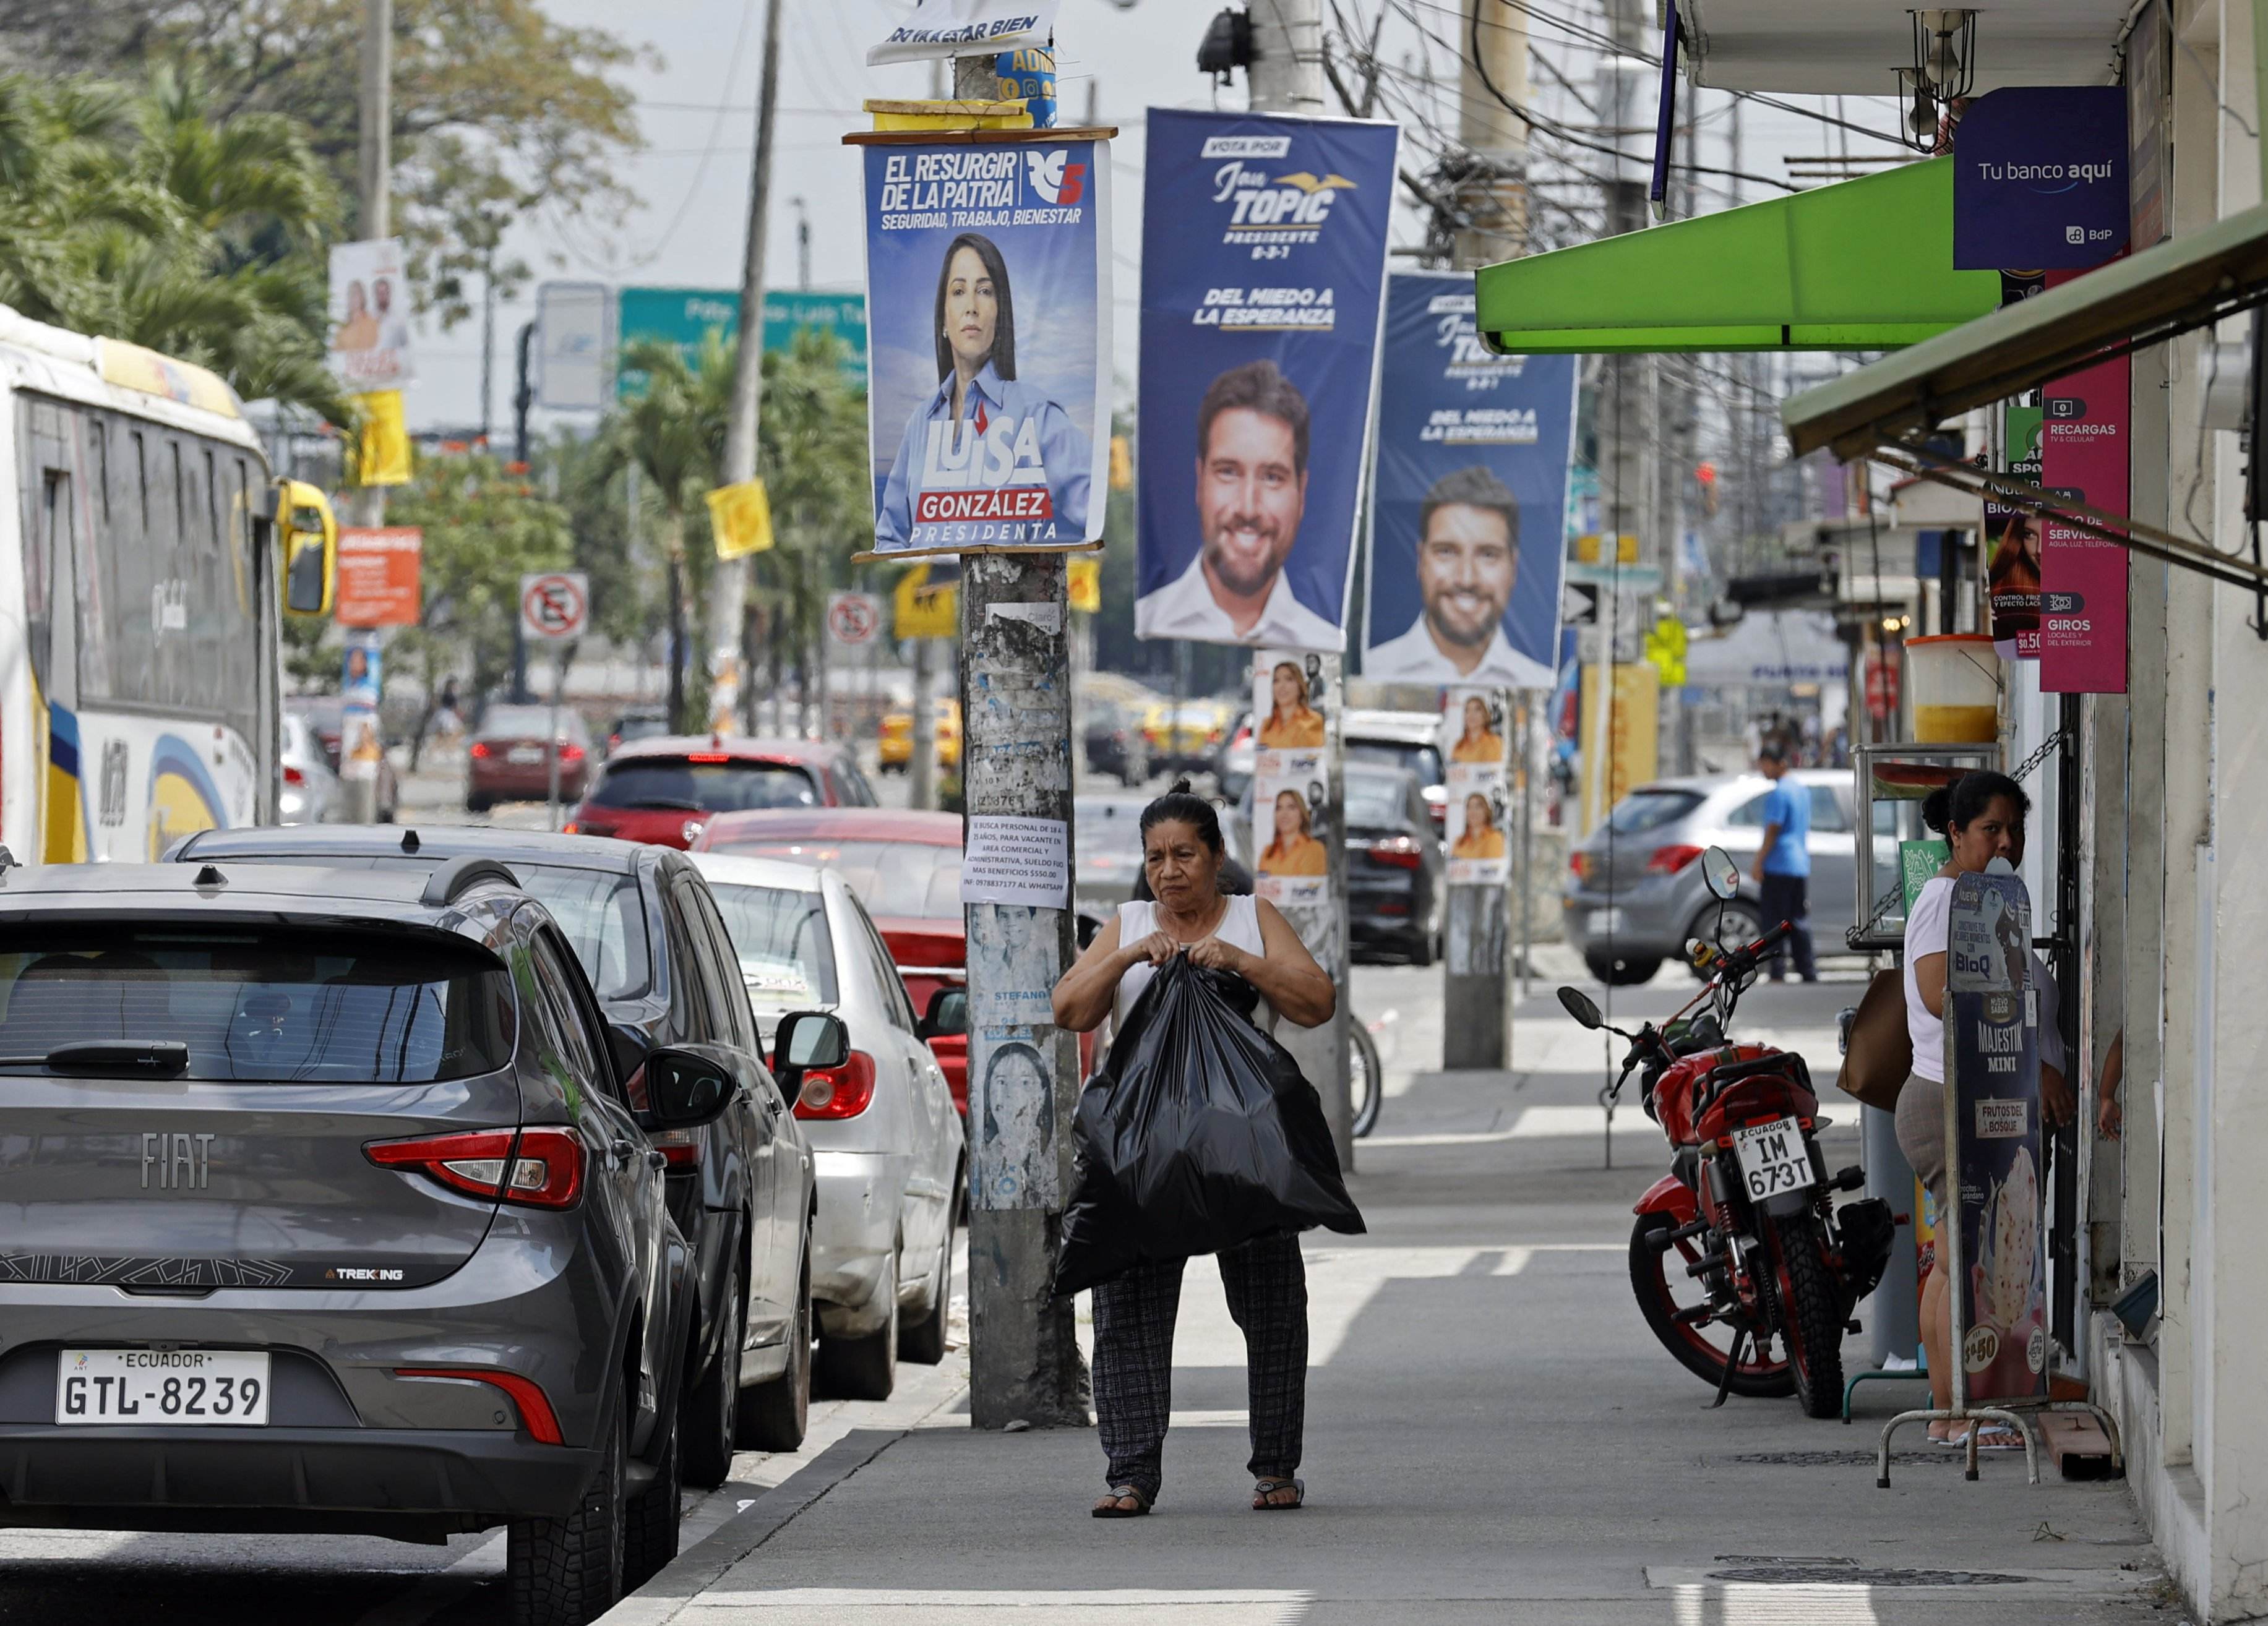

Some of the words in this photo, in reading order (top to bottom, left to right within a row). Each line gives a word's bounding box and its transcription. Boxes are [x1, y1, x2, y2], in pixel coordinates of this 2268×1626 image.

[989, 15, 1038, 35] BIEN
[1211, 142, 1246, 152] VOTA
[1251, 141, 1281, 152] POR
[885, 155, 910, 182] EL
[915, 152, 1017, 182] RESURGIR
[1978, 163, 2002, 180] Tu
[2007, 161, 2063, 179] banco
[2068, 160, 2113, 183] aquí
[881, 182, 909, 210] DE
[912, 182, 940, 209] LA
[941, 180, 1015, 208] PATRIA
[1230, 189, 1335, 224] TOPIC
[882, 211, 948, 230] SEGURIDAD,
[951, 210, 1011, 228] TRABAJO,
[1013, 208, 1081, 225] BIENESTAR
[2089, 229, 2113, 240] BdP
[1204, 288, 1244, 306] DEL
[1247, 288, 1316, 306] MIEDO
[1315, 288, 1334, 306] A
[1192, 309, 1220, 325] LA
[1220, 308, 1335, 325] ESPERANZA
[2050, 424, 2116, 435] RECARGAS
[922, 489, 1045, 519] GONZÁLEZ
[909, 523, 1057, 543] PRESIDENTA
[2048, 620, 2090, 630] GIROS
[1000, 823, 1037, 832] PERSONAL
[1021, 836, 1052, 844] VACANTE
[1001, 845, 1042, 854] COMERCIAL
[1024, 858, 1052, 866] SUELDO
[987, 868, 1028, 876] BENEFICIOS
[1030, 869, 1057, 878] $550.00
[1028, 883, 1063, 891] WHATSAPP
[1991, 1006, 2008, 1014] SABOR
[1978, 1019, 2023, 1053] MAJESTIK
[1988, 1056, 2016, 1072] MINI
[1982, 1106, 2011, 1118] FRUTOS
[2012, 1106, 2023, 1116] DEL
[1741, 1121, 1789, 1138] ECUADOR
[1988, 1121, 2017, 1132] BOSQUE
[141, 1133, 215, 1189] FIAT
[336, 1267, 404, 1280] TREKKING
[126, 1353, 204, 1367] ECUADOR
[66, 1376, 260, 1416] GTL-8239
